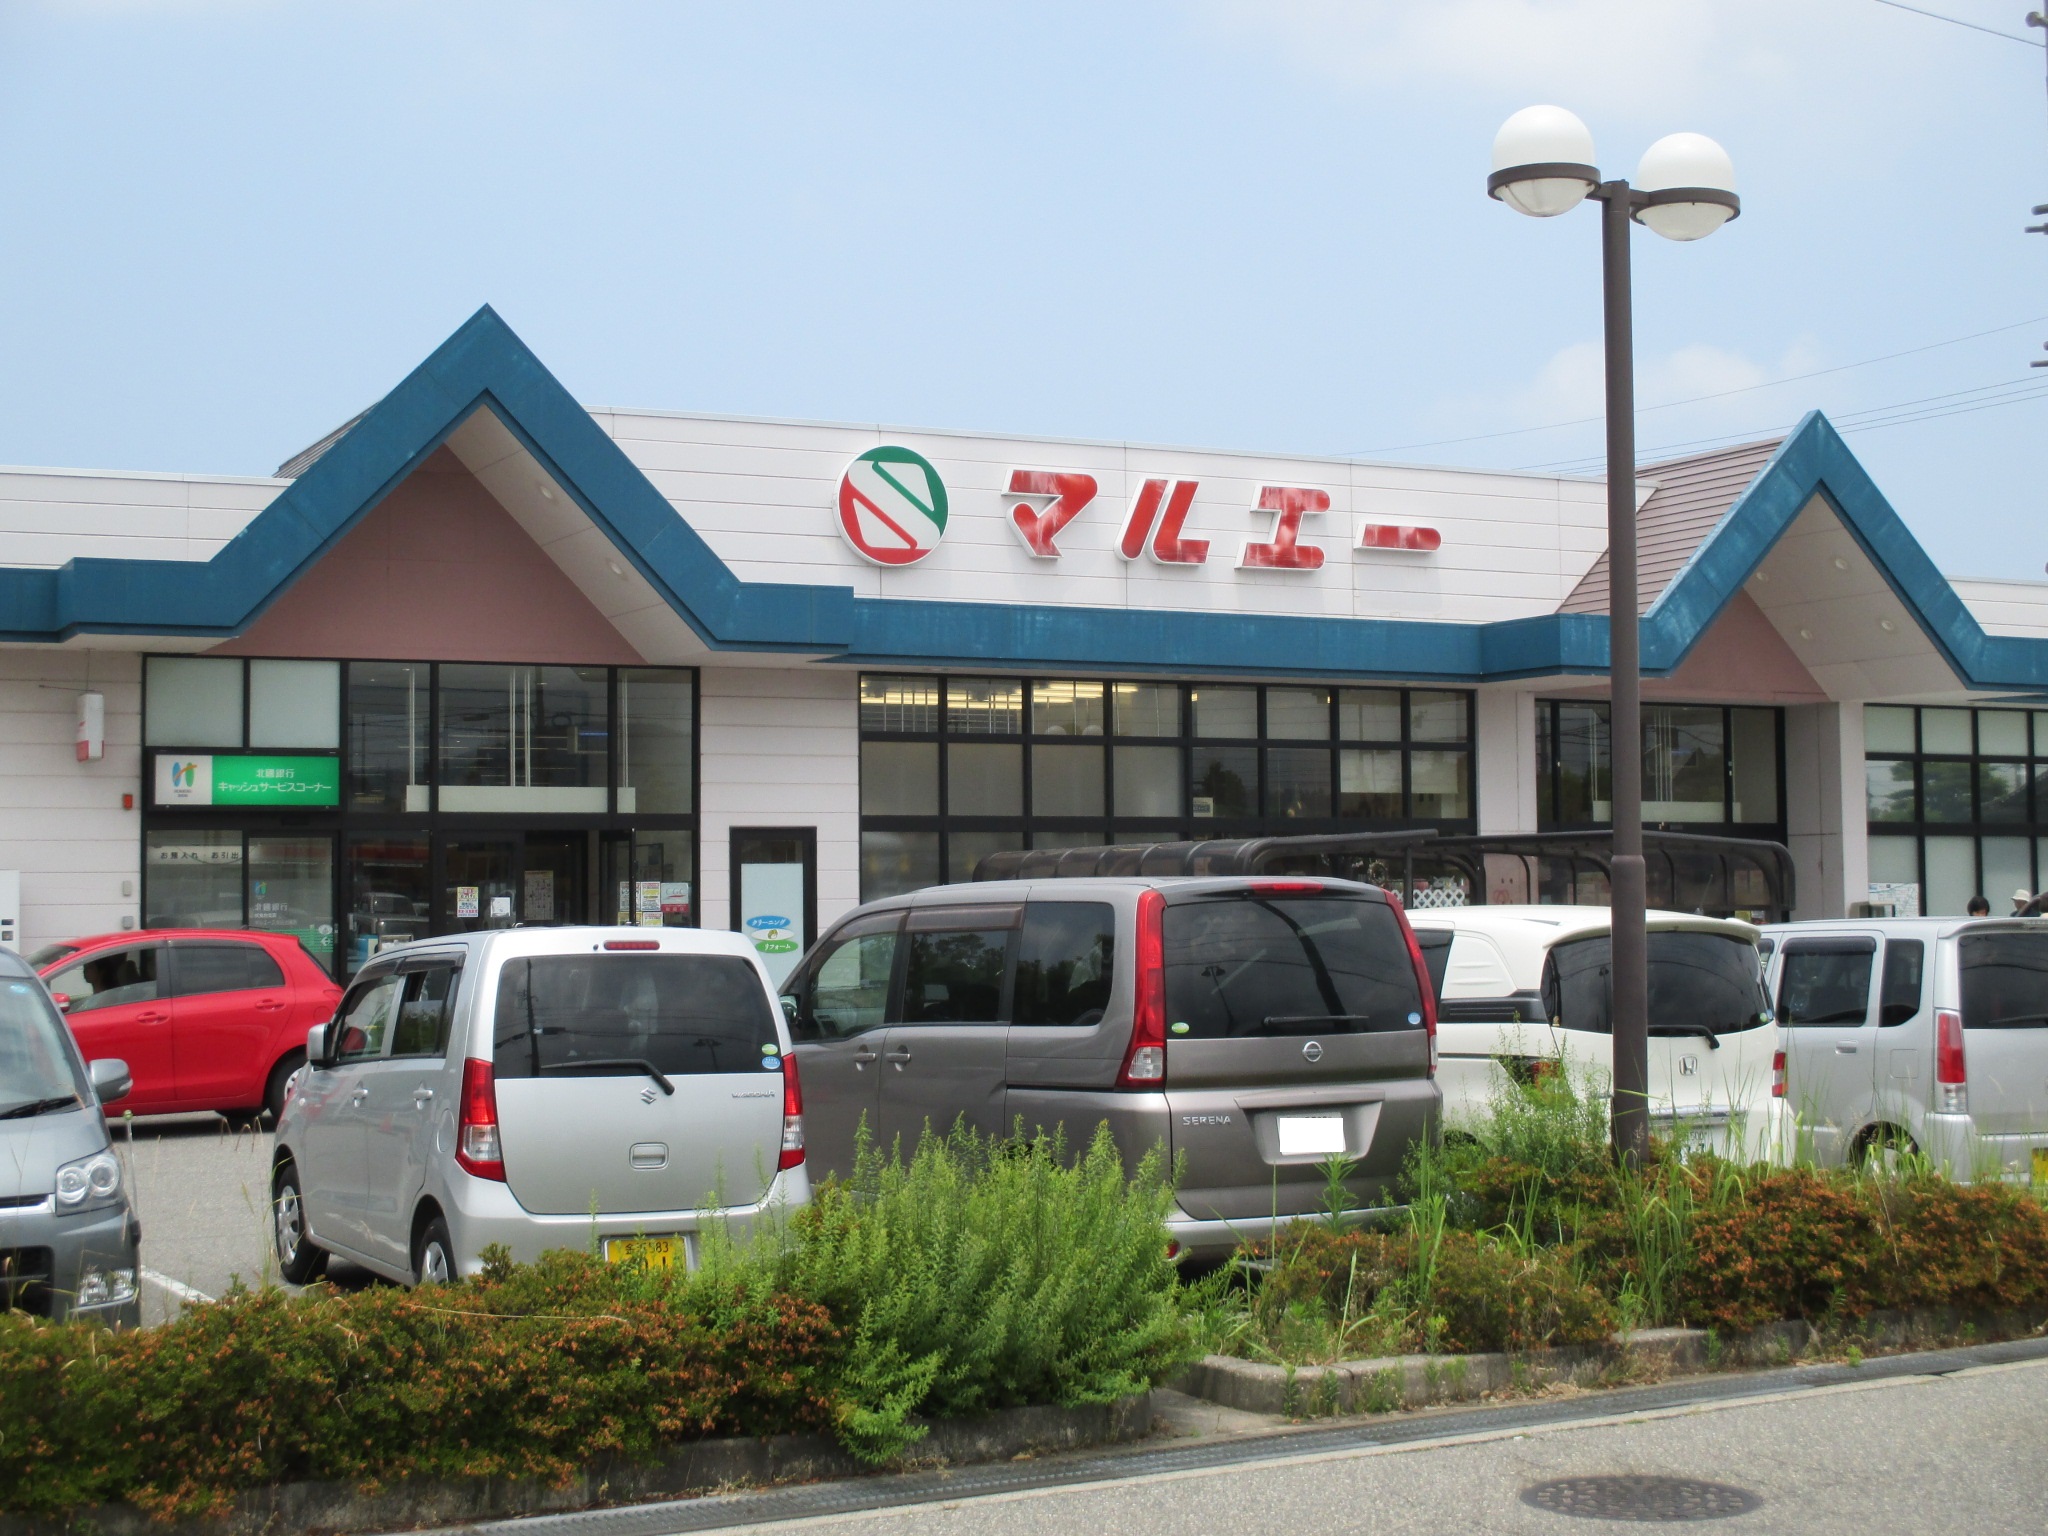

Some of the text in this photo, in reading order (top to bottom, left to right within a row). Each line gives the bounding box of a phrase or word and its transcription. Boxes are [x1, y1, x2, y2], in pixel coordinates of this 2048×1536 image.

[1001, 468, 1443, 571] マルエー
[217, 781, 332, 793] キャッシュサービスコーナー
[1182, 1115, 1232, 1126] SERENA
